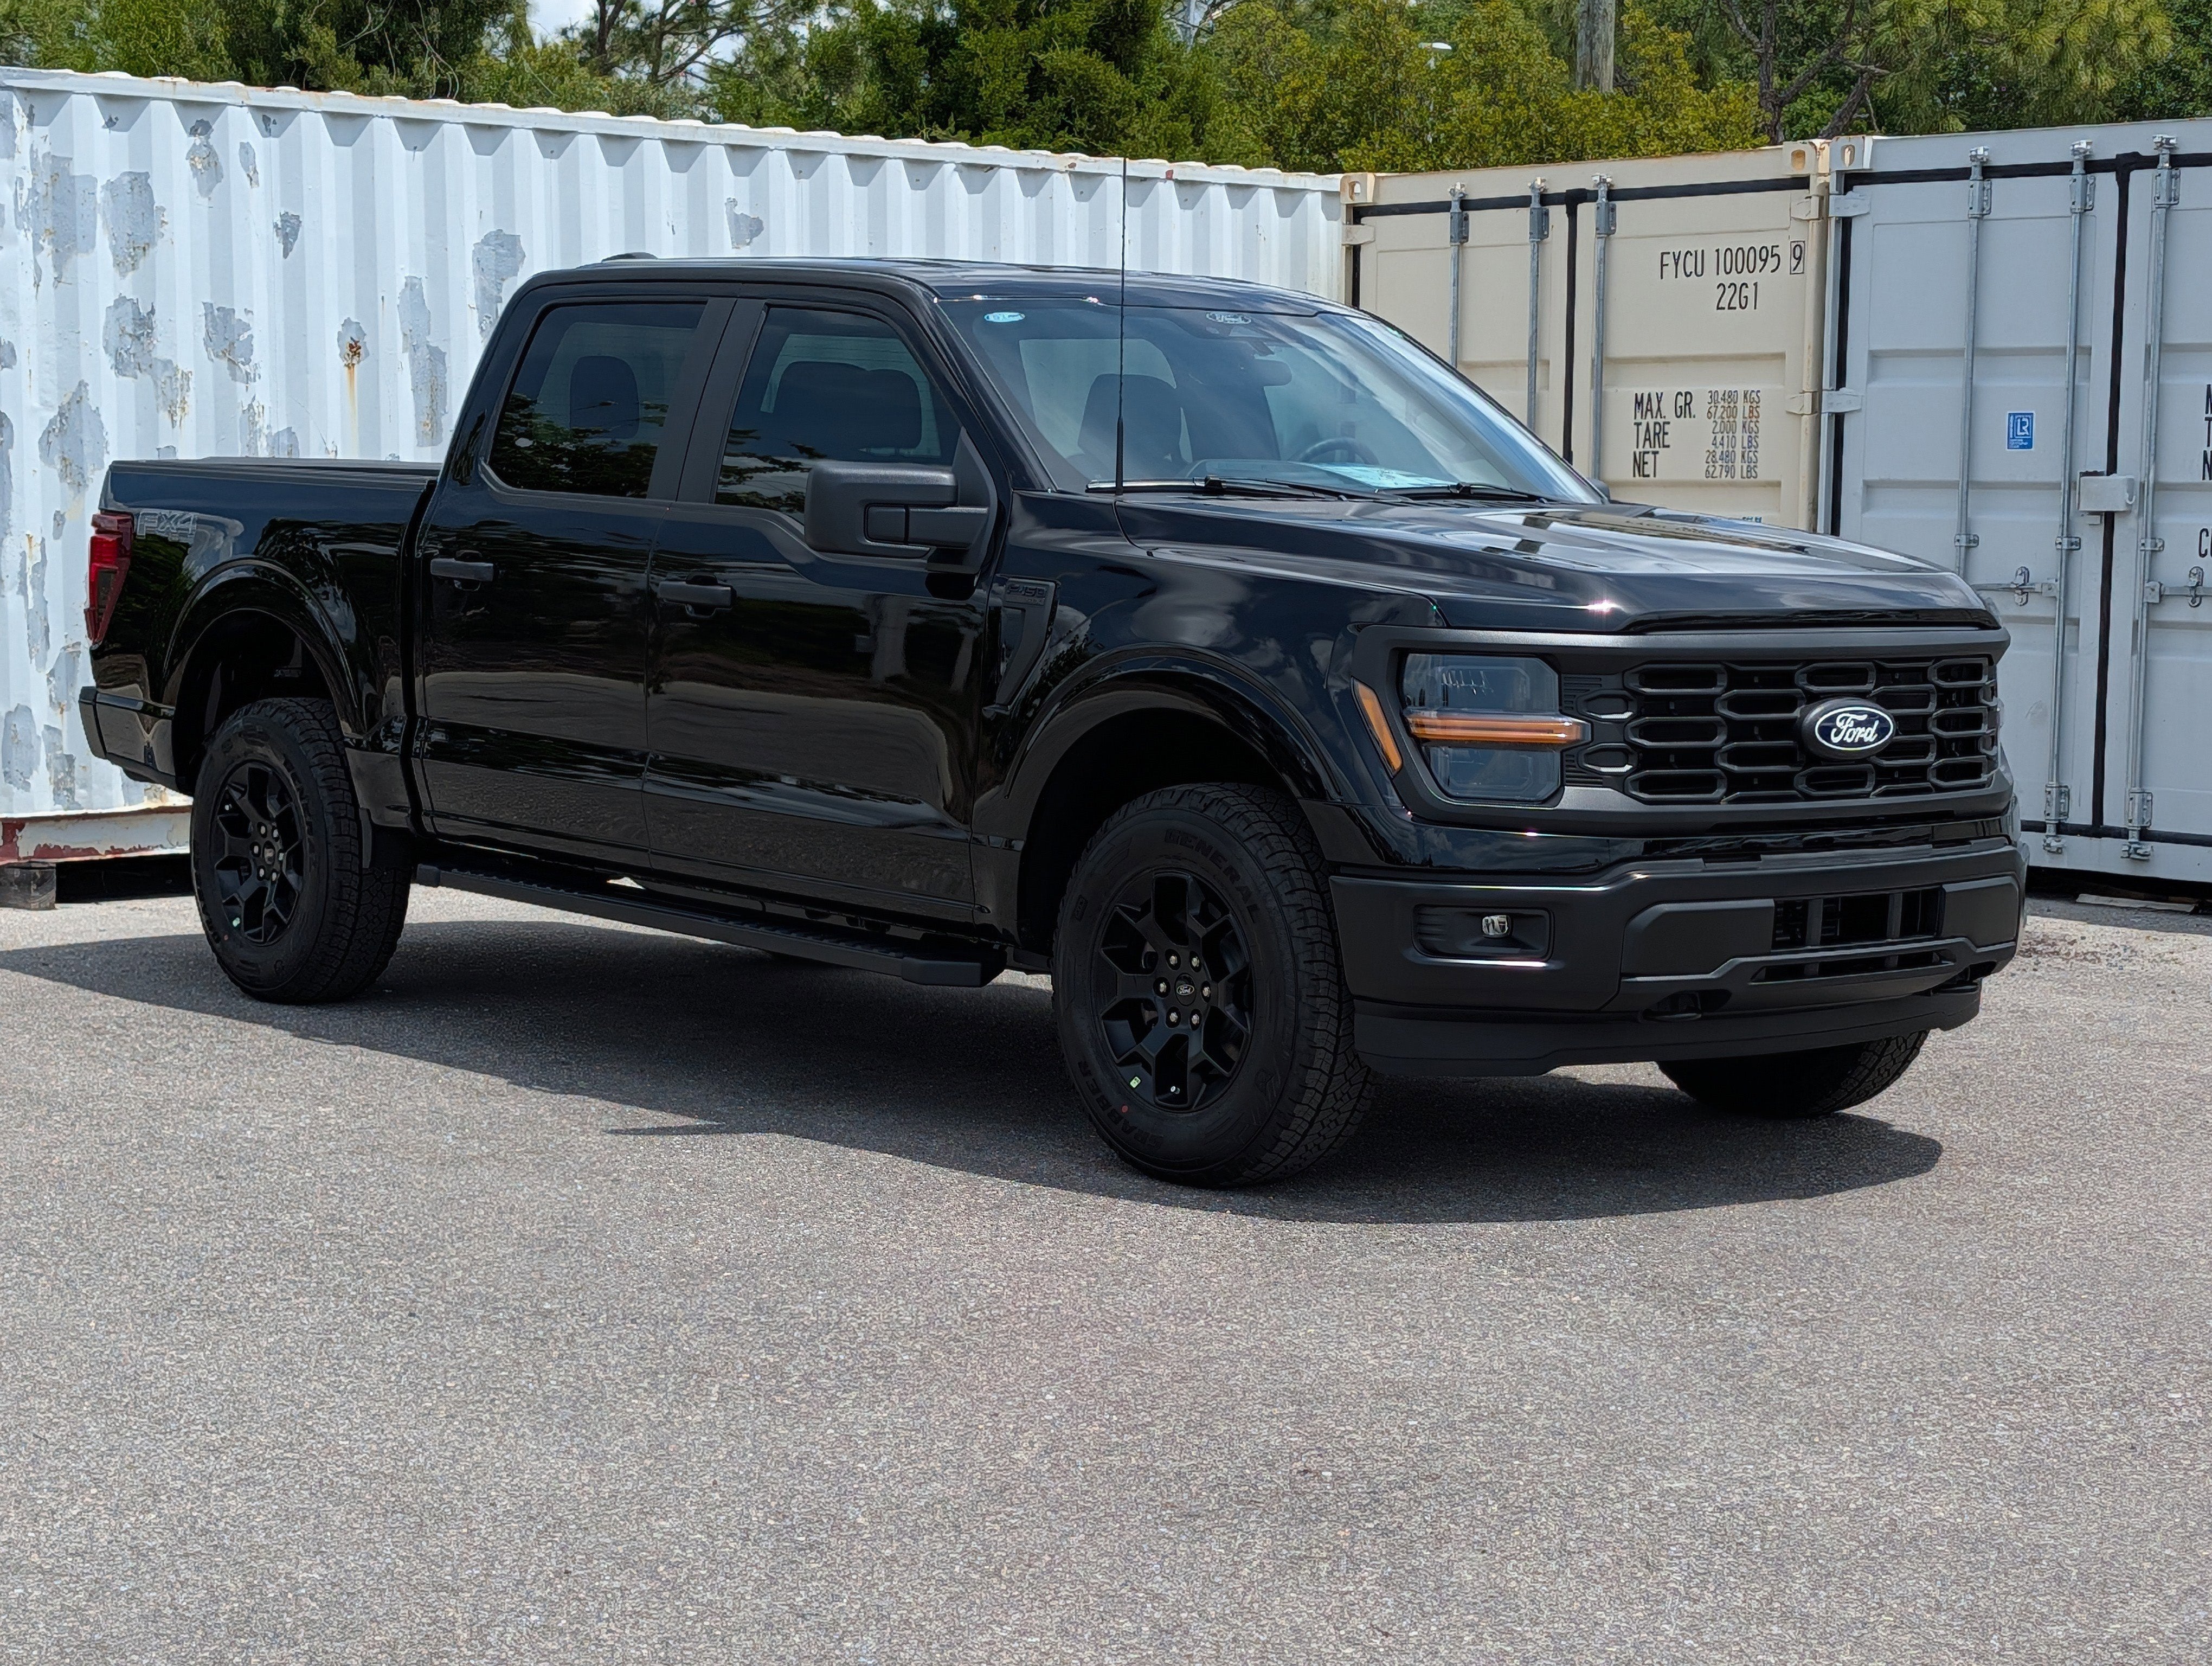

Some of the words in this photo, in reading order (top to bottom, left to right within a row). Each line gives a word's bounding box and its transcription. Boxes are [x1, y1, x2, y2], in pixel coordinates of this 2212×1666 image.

[1660, 249, 1705, 279] FYCU
[1715, 245, 1781, 275] 100095
[1791, 242, 1804, 273] 9
[1716, 281, 1758, 311] 22G1
[1634, 392, 1667, 420] MAX.
[1674, 391, 1696, 419] GR.
[1743, 389, 1761, 405] KGS
[1742, 405, 1760, 419] LBS
[1634, 421, 1671, 449] TARE
[1741, 420, 1759, 434] KGS
[1741, 435, 1759, 449] LBS
[1633, 450, 1659, 478] NET
[1740, 450, 1759, 464] KGS
[1740, 465, 1758, 479] LBS
[137, 509, 196, 540] FX4
[1830, 713, 1880, 744] Ford
[1164, 828, 1259, 924] GENERAL
